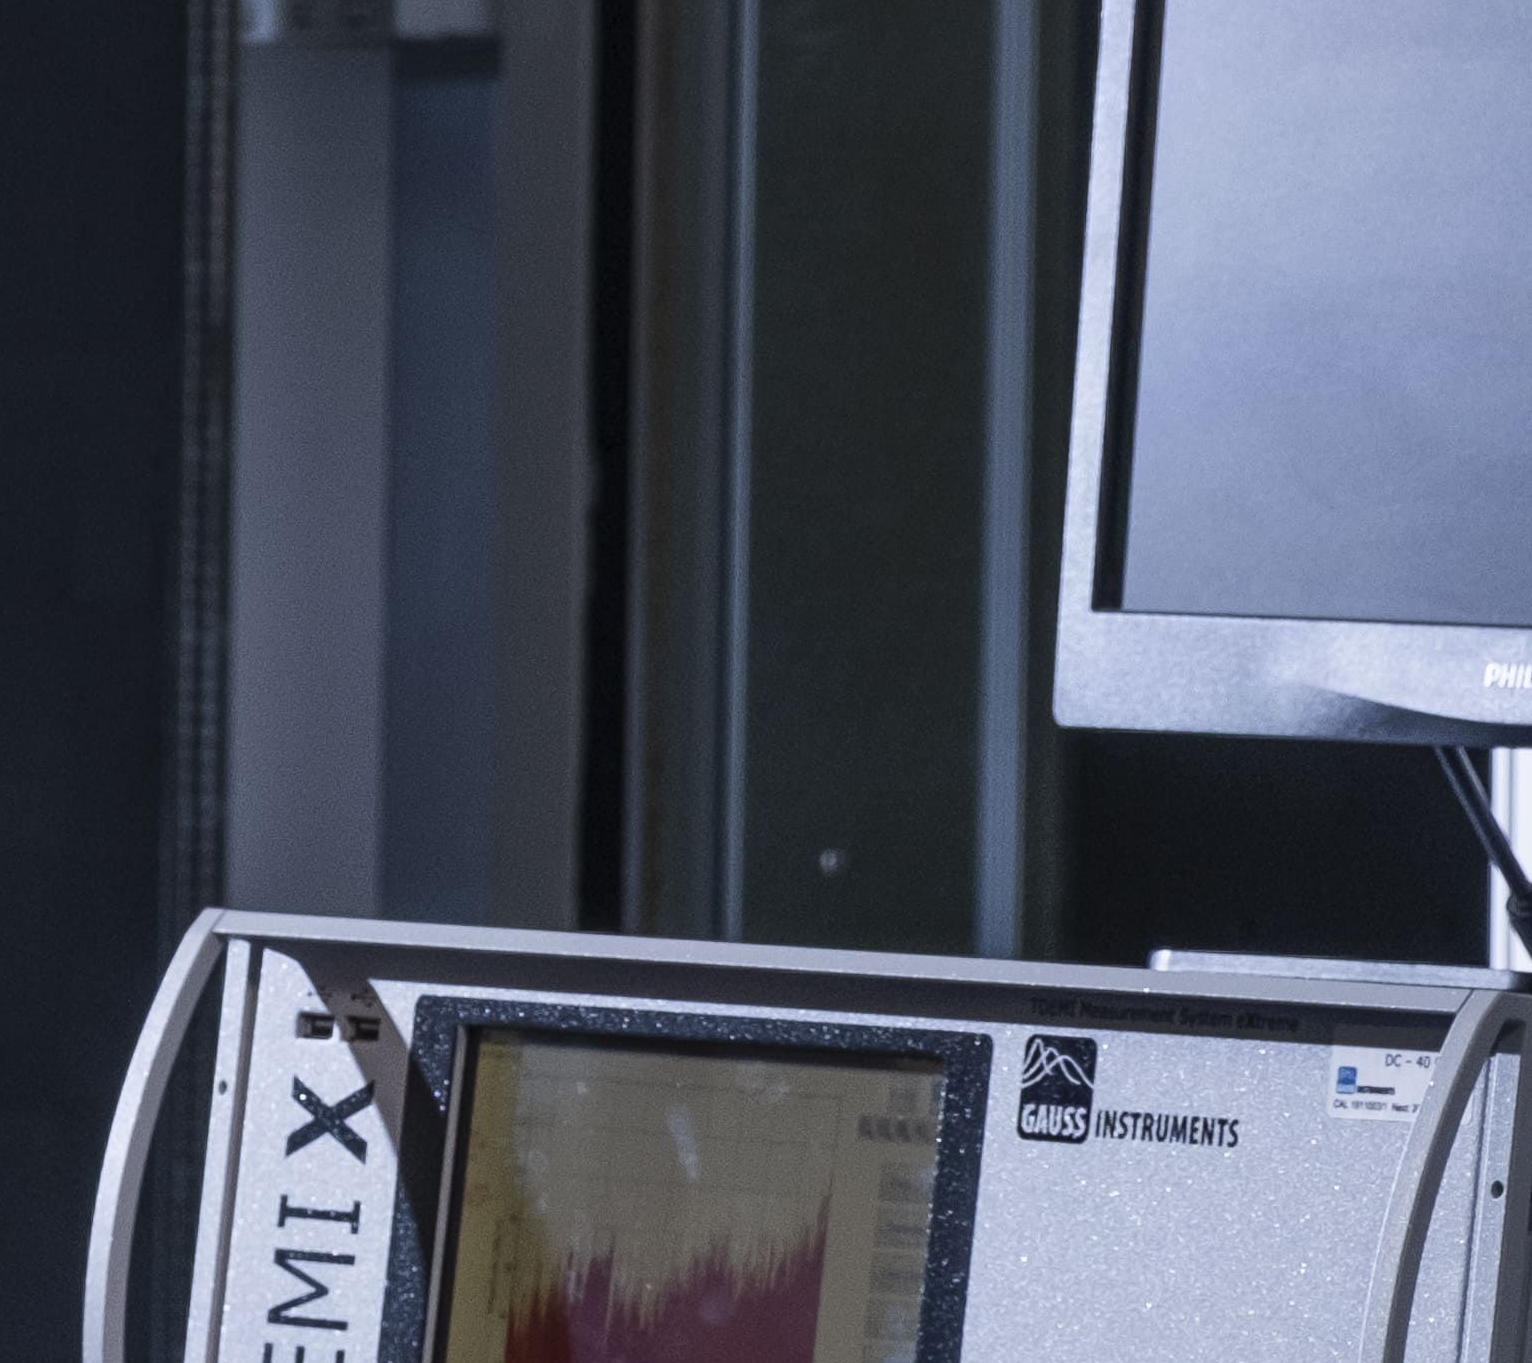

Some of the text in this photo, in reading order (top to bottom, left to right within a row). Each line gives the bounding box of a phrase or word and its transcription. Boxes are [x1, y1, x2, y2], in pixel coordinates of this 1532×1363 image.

[1385, 1053, 1403, 1067] DC
[1020, 1102, 1087, 1138] GAUSS
[1095, 1109, 1240, 1148] INSTRUMENTS
